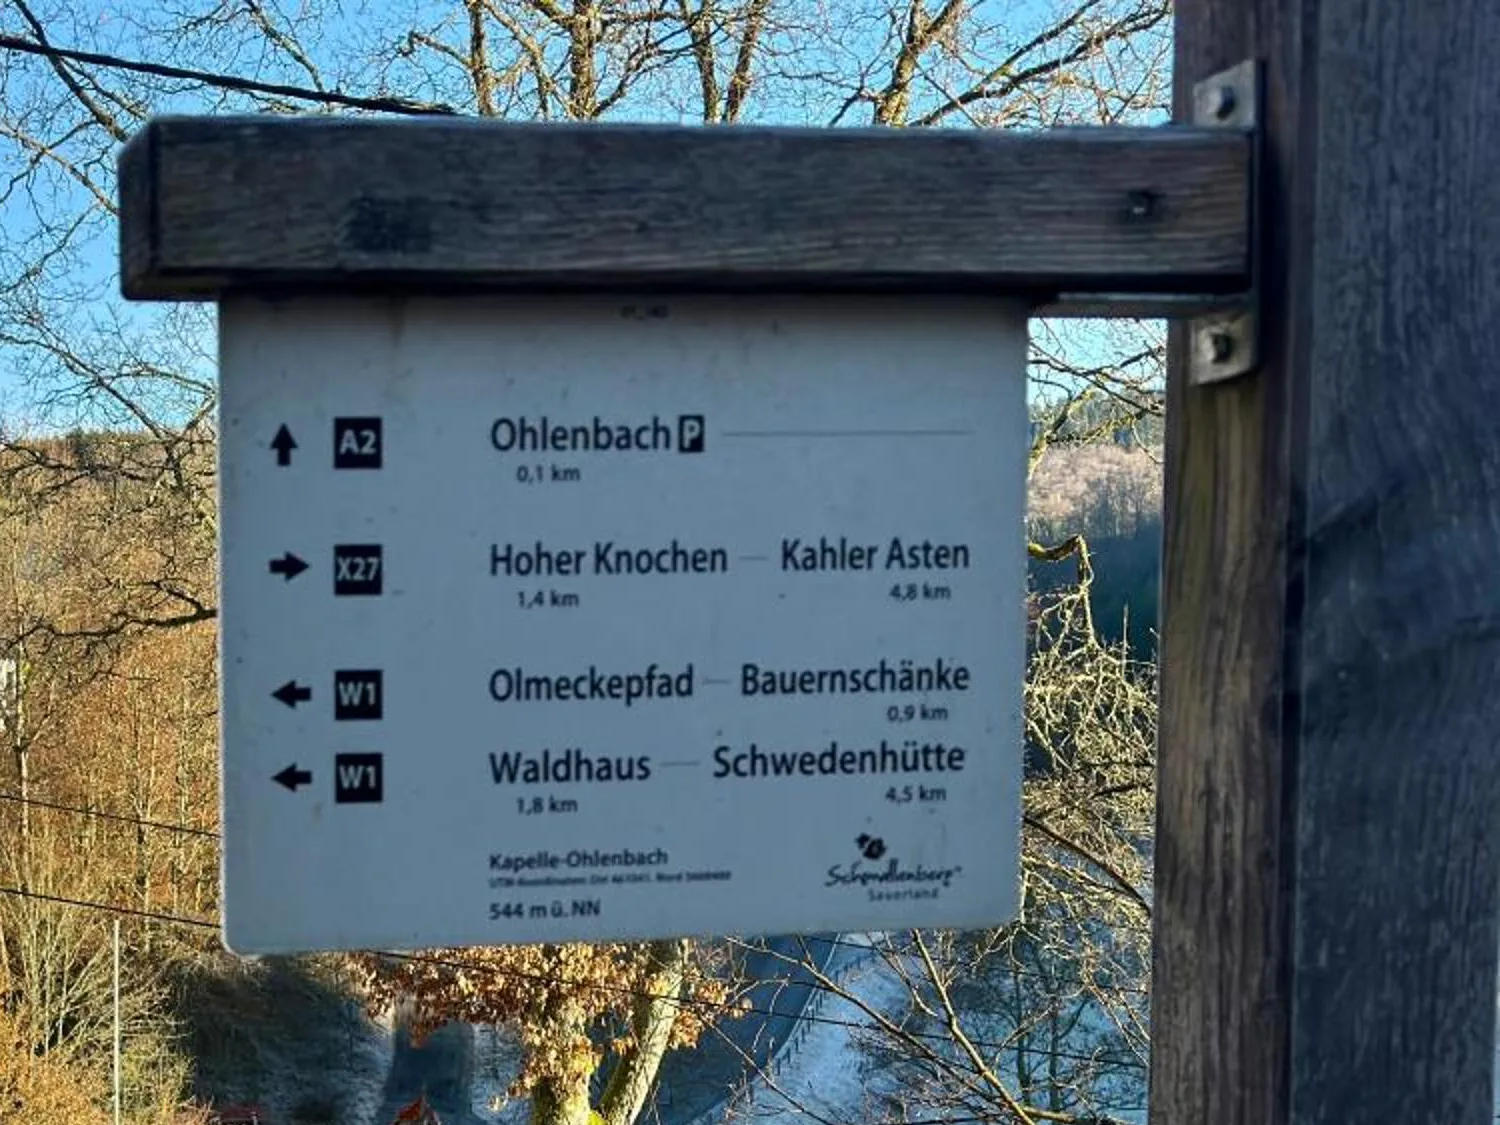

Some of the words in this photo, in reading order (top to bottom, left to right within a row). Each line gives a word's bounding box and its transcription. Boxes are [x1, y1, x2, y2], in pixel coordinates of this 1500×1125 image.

[340, 430, 375, 454] A2
[491, 416, 671, 451] Ohlenbach
[683, 421, 700, 448] P
[516, 465, 543, 484] 0,1
[551, 464, 580, 481] km
[491, 542, 586, 576] Hoher
[595, 540, 727, 574] Knochen
[782, 537, 878, 571] Kahler
[885, 538, 969, 569] Asten
[337, 557, 381, 581] X27
[518, 591, 542, 608] 1,4
[550, 591, 579, 606] km
[890, 584, 917, 600] 4,8
[923, 584, 950, 599] km
[489, 664, 693, 706] Olmeckepfad
[742, 658, 969, 696] Bauernschänke
[339, 682, 375, 705] W1
[887, 705, 915, 722] 0,9
[920, 704, 948, 720] km
[489, 749, 650, 784] Waldhaus
[714, 741, 964, 778] Schwedenhütte
[340, 766, 375, 788] W1
[518, 797, 542, 815] 1,8
[549, 796, 577, 812] km
[886, 786, 912, 803] 4,5
[919, 786, 946, 800] km
[490, 848, 668, 873] Kapelle-Ohlenbach
[490, 903, 523, 920] 544
[530, 906, 547, 917] m
[572, 901, 600, 916] NN
